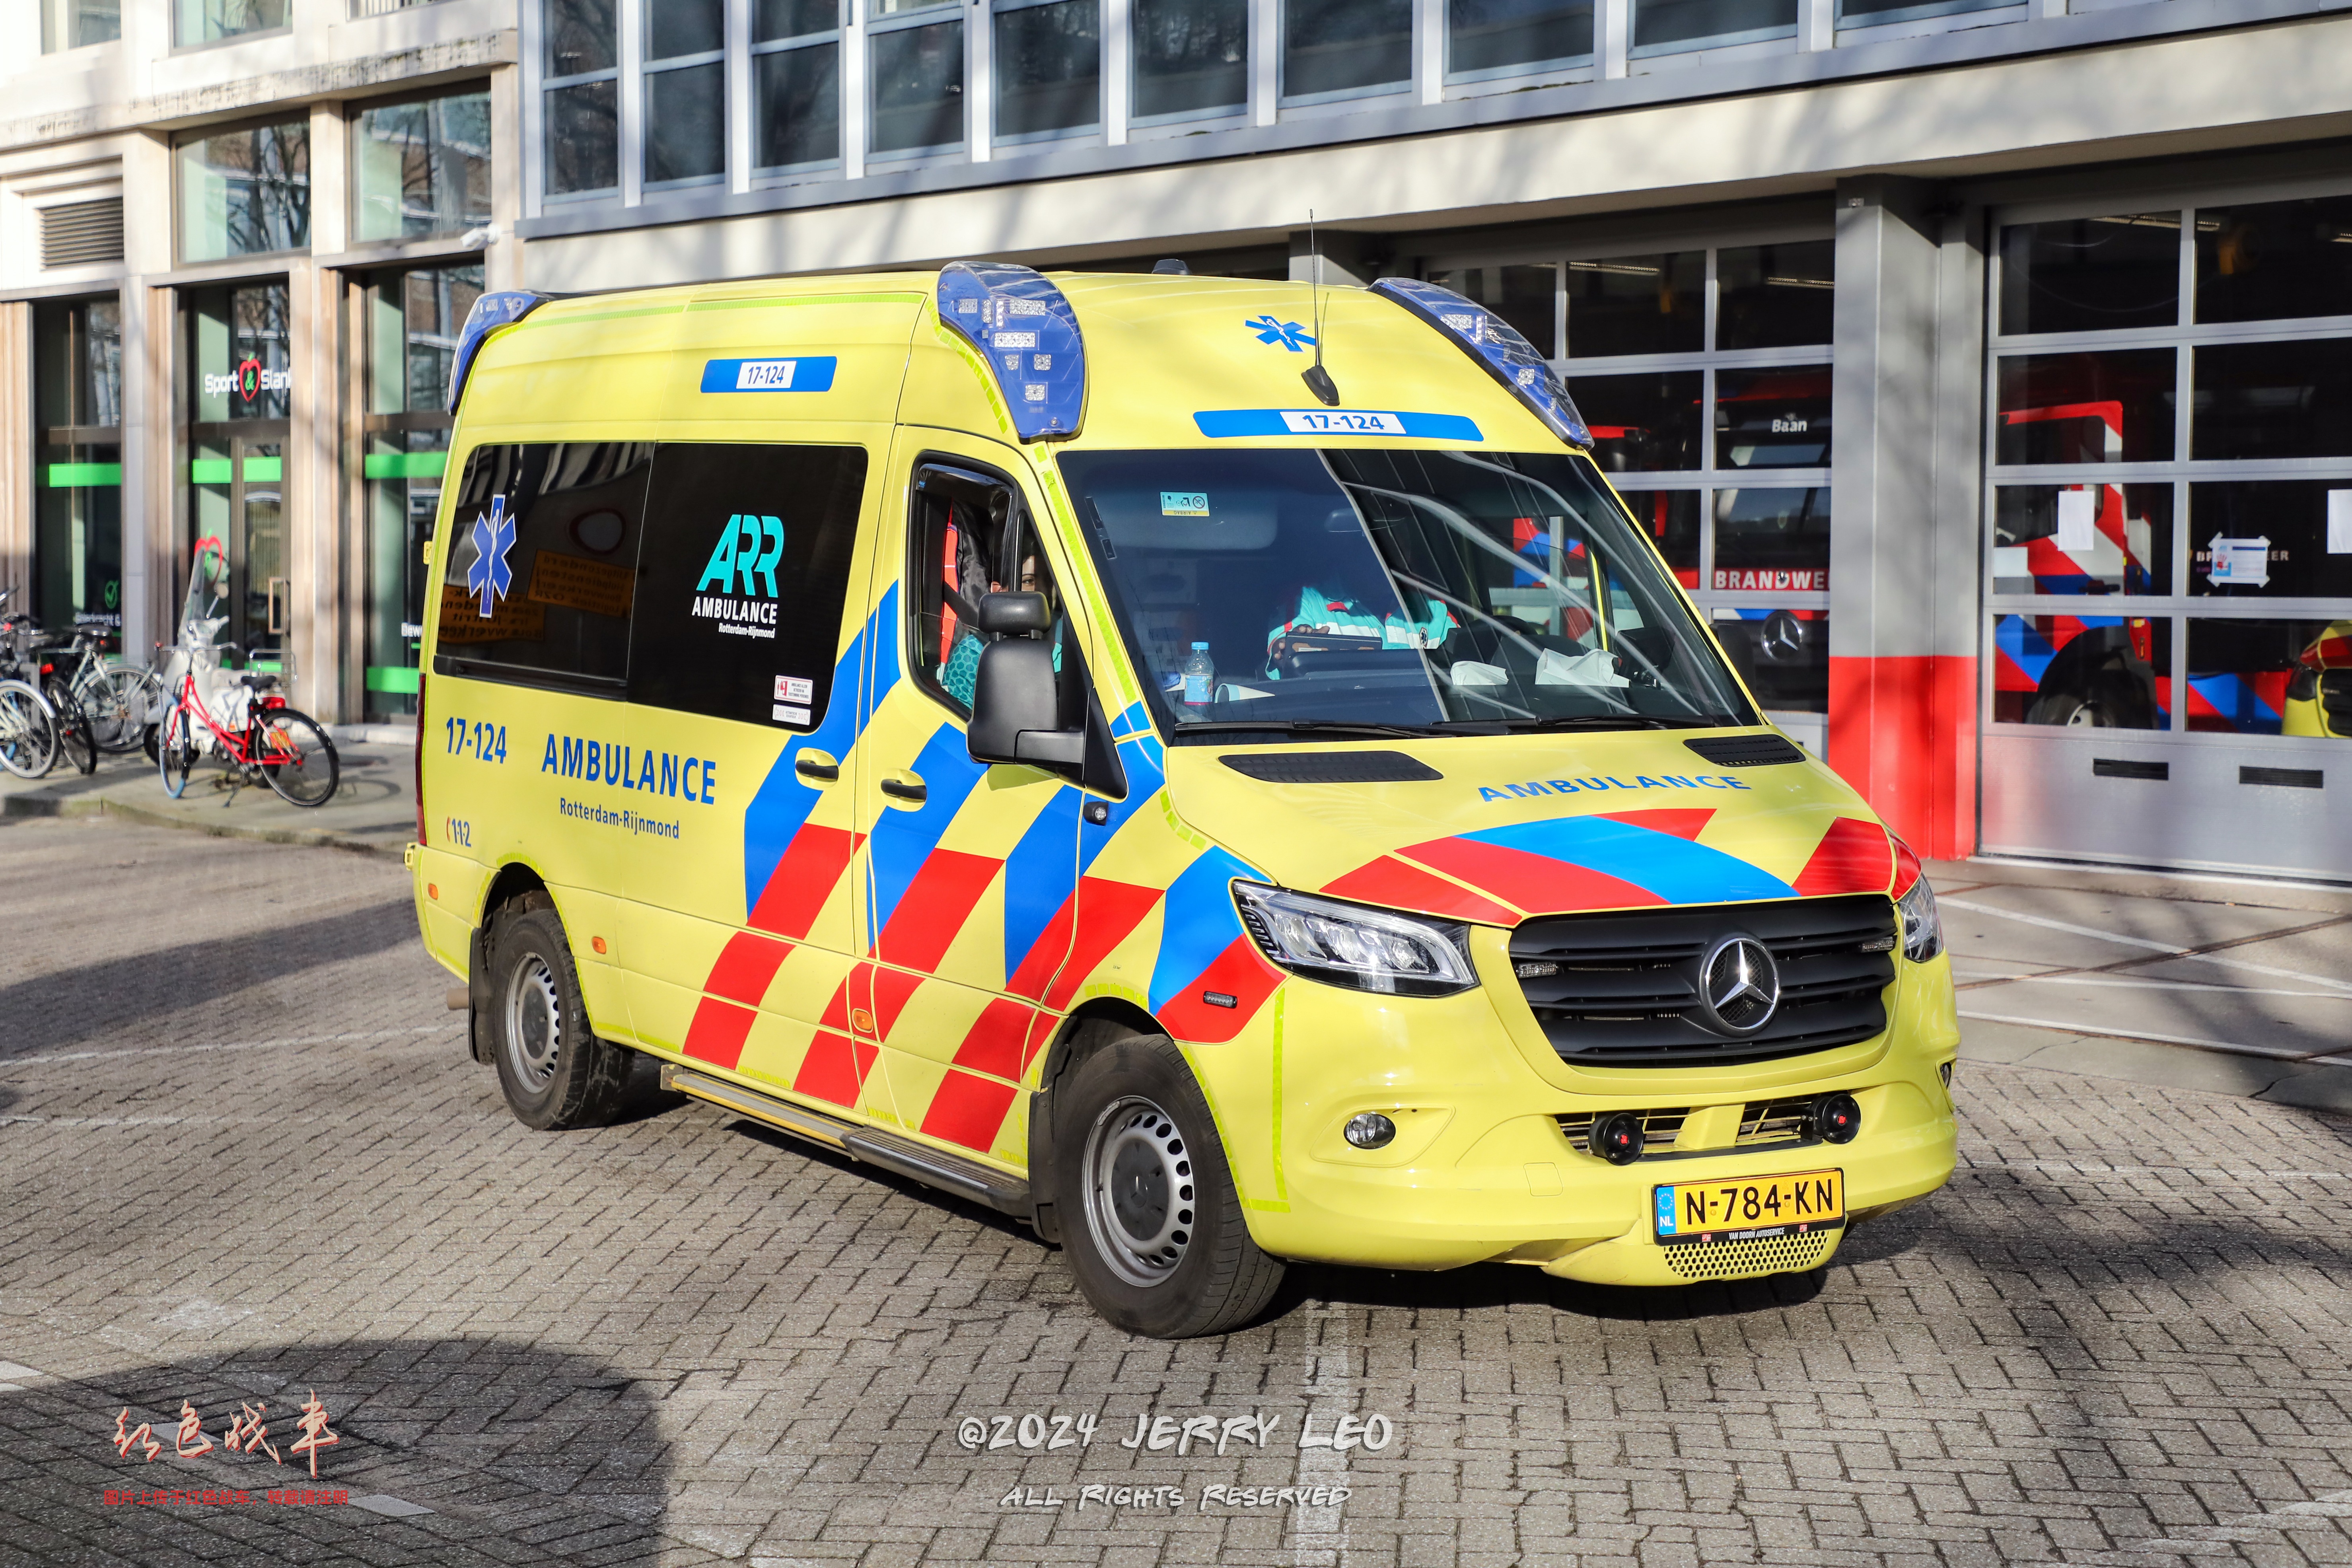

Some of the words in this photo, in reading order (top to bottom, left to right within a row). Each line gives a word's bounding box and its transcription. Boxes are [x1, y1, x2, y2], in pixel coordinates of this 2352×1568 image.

[205, 370, 239, 398] Sport
[245, 370, 255, 391] &
[748, 366, 785, 384] 17-124
[1302, 414, 1385, 430] 17-124
[1772, 419, 1807, 433] Baan
[696, 514, 784, 598] ARR
[1715, 570, 1830, 589] BRANDWE
[691, 596, 778, 624] AMBULANCE
[718, 622, 775, 639] Rotterdam-Rijnmond
[446, 716, 507, 764] 17-124
[541, 733, 716, 805] AMBULANCE
[1478, 776, 1753, 802] AMBULANCE
[560, 798, 679, 839] Rotterdam-Rijnmond
[1686, 1179, 1833, 1226] N-784-KN
[1659, 1215, 1674, 1227] NL
[1739, 1230, 1755, 1239] DOORN
[1755, 1227, 1785, 1239] AUTOSERVICE
